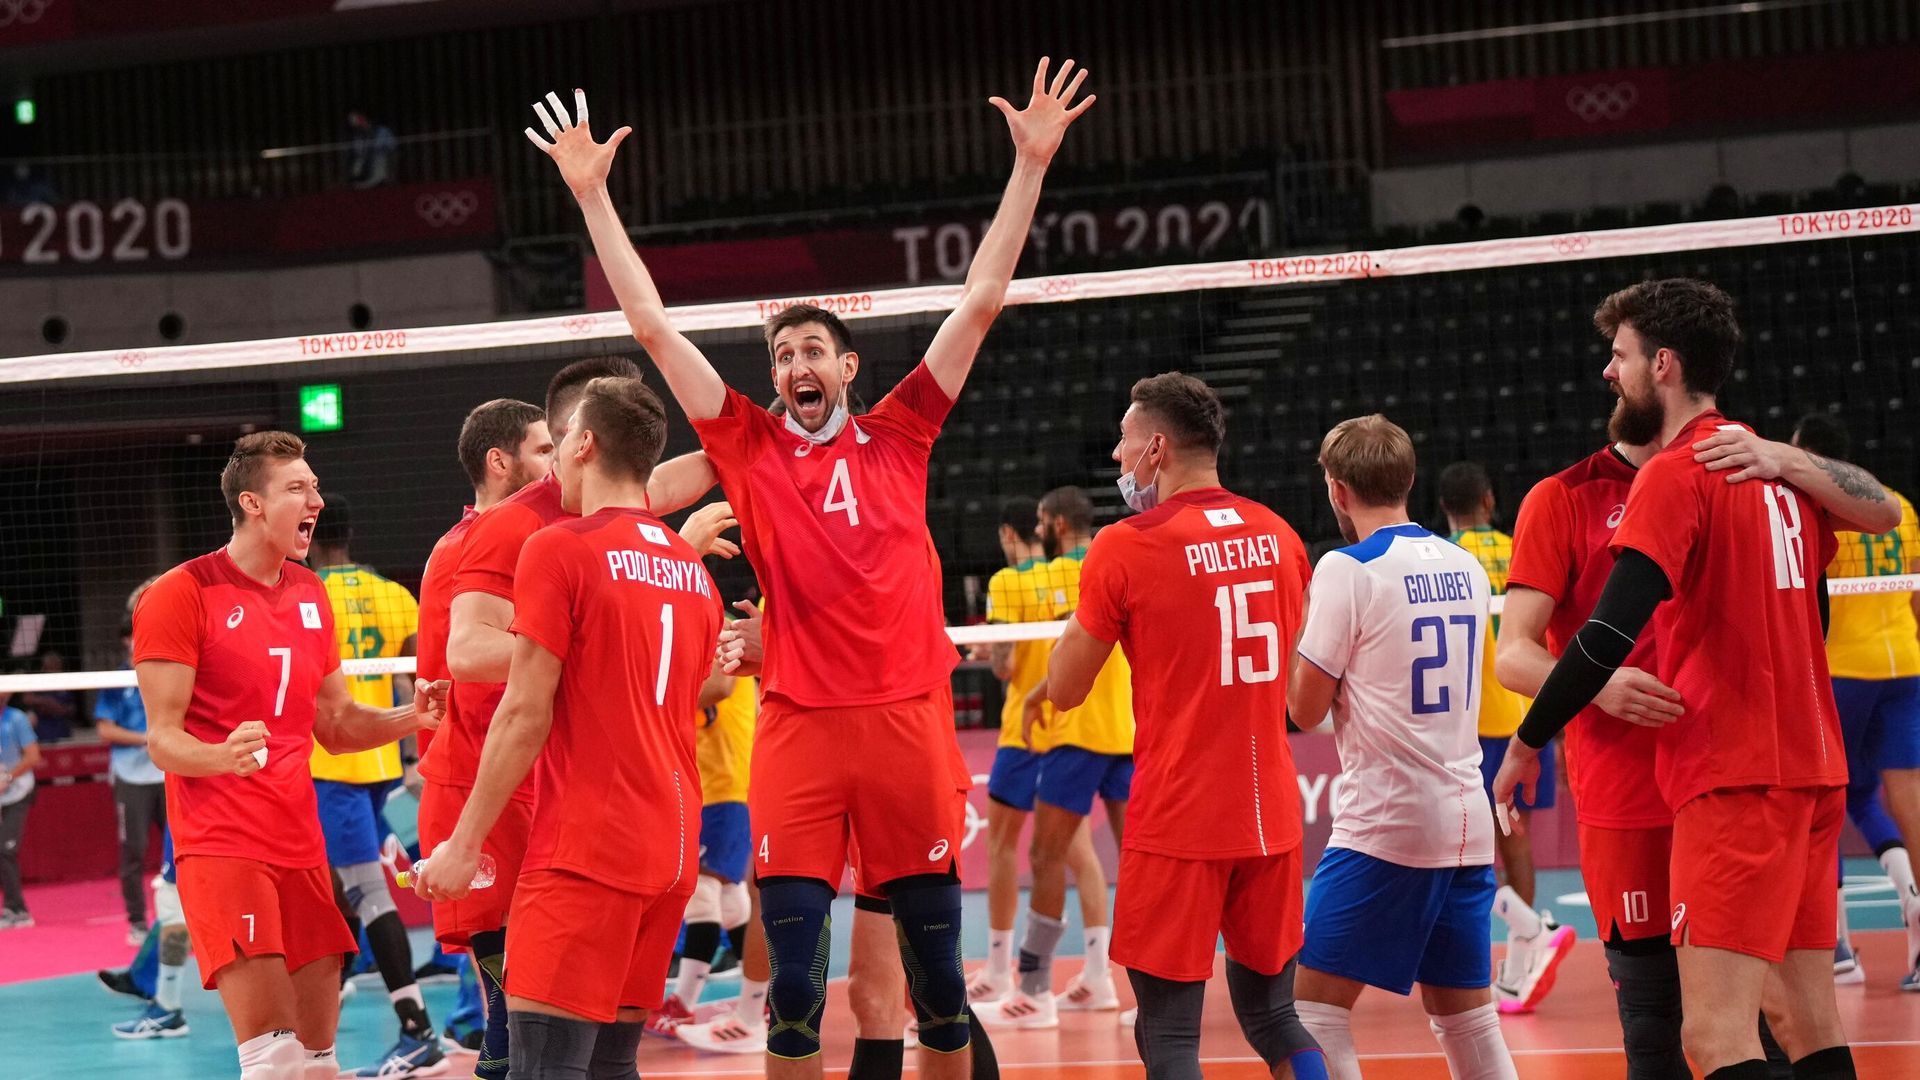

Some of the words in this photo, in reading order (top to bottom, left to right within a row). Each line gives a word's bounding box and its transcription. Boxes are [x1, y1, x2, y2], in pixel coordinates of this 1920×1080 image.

[20, 199, 191, 263] 2020
[1778, 212, 1851, 236] TOKYO
[1858, 207, 1912, 229] 2020
[895, 210, 1099, 283] TOYO
[1248, 258, 1316, 280] TOKYO
[1322, 254, 1370, 275] 2020
[824, 294, 872, 314] 2020
[299, 334, 358, 355] TOKYO
[362, 331, 407, 350] 2020
[823, 457, 860, 527] 4
[1184, 534, 1280, 577] POLETAEV
[1763, 484, 1805, 590] 18
[1860, 529, 1903, 577] 13
[606, 549, 711, 600] PODLESNYKH
[1403, 571, 1473, 605] GOLUBEV
[1833, 583, 1877, 594] TOKYO
[1880, 580, 1914, 591] 2020
[347, 627, 385, 682] 12
[655, 603, 674, 706] 1
[1214, 579, 1279, 687] 15
[268, 647, 292, 716] 7
[1411, 615, 1477, 715] 27
[758, 834, 769, 863] 4
[241, 913, 255, 942] 7
[1622, 890, 1649, 923] 10
